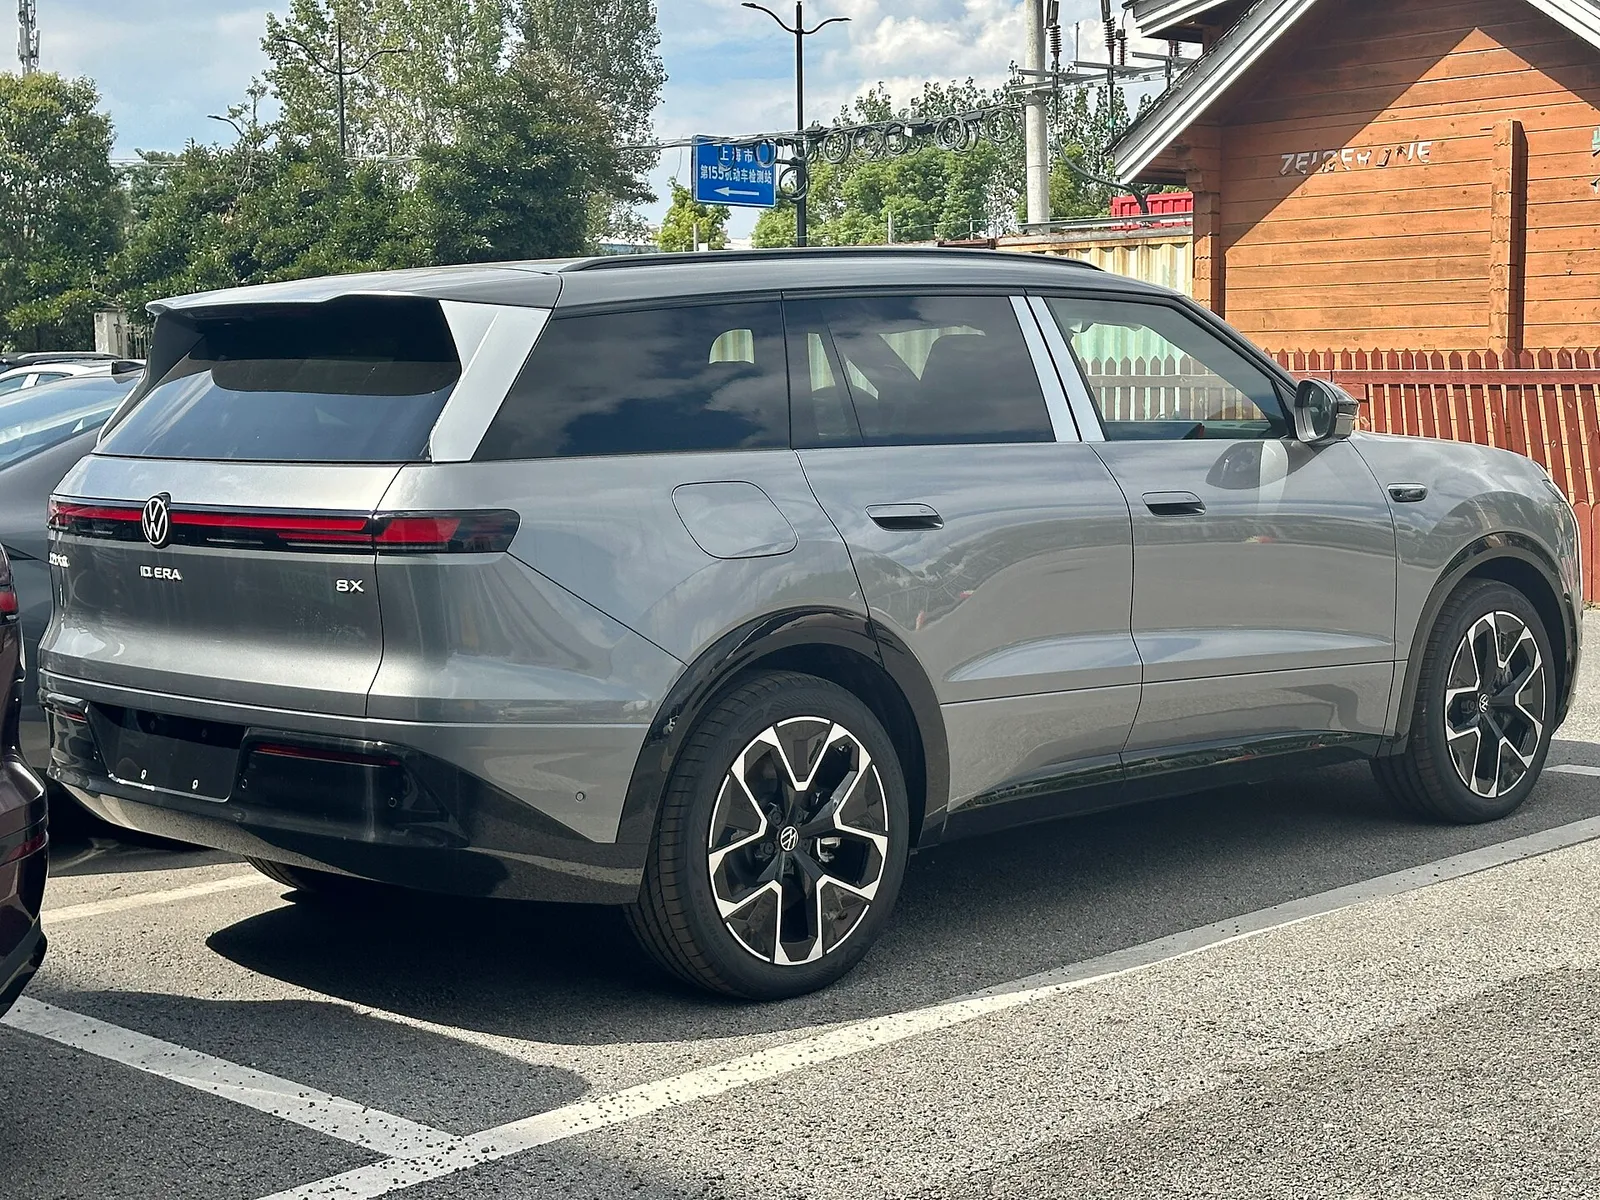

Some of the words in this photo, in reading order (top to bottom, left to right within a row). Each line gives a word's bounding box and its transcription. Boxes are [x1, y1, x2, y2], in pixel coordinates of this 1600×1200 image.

[720, 146, 754, 163] 上海市
[700, 164, 772, 185] 第155机动车检测站
[154, 567, 182, 581] ERA
[336, 579, 365, 593] 8X
